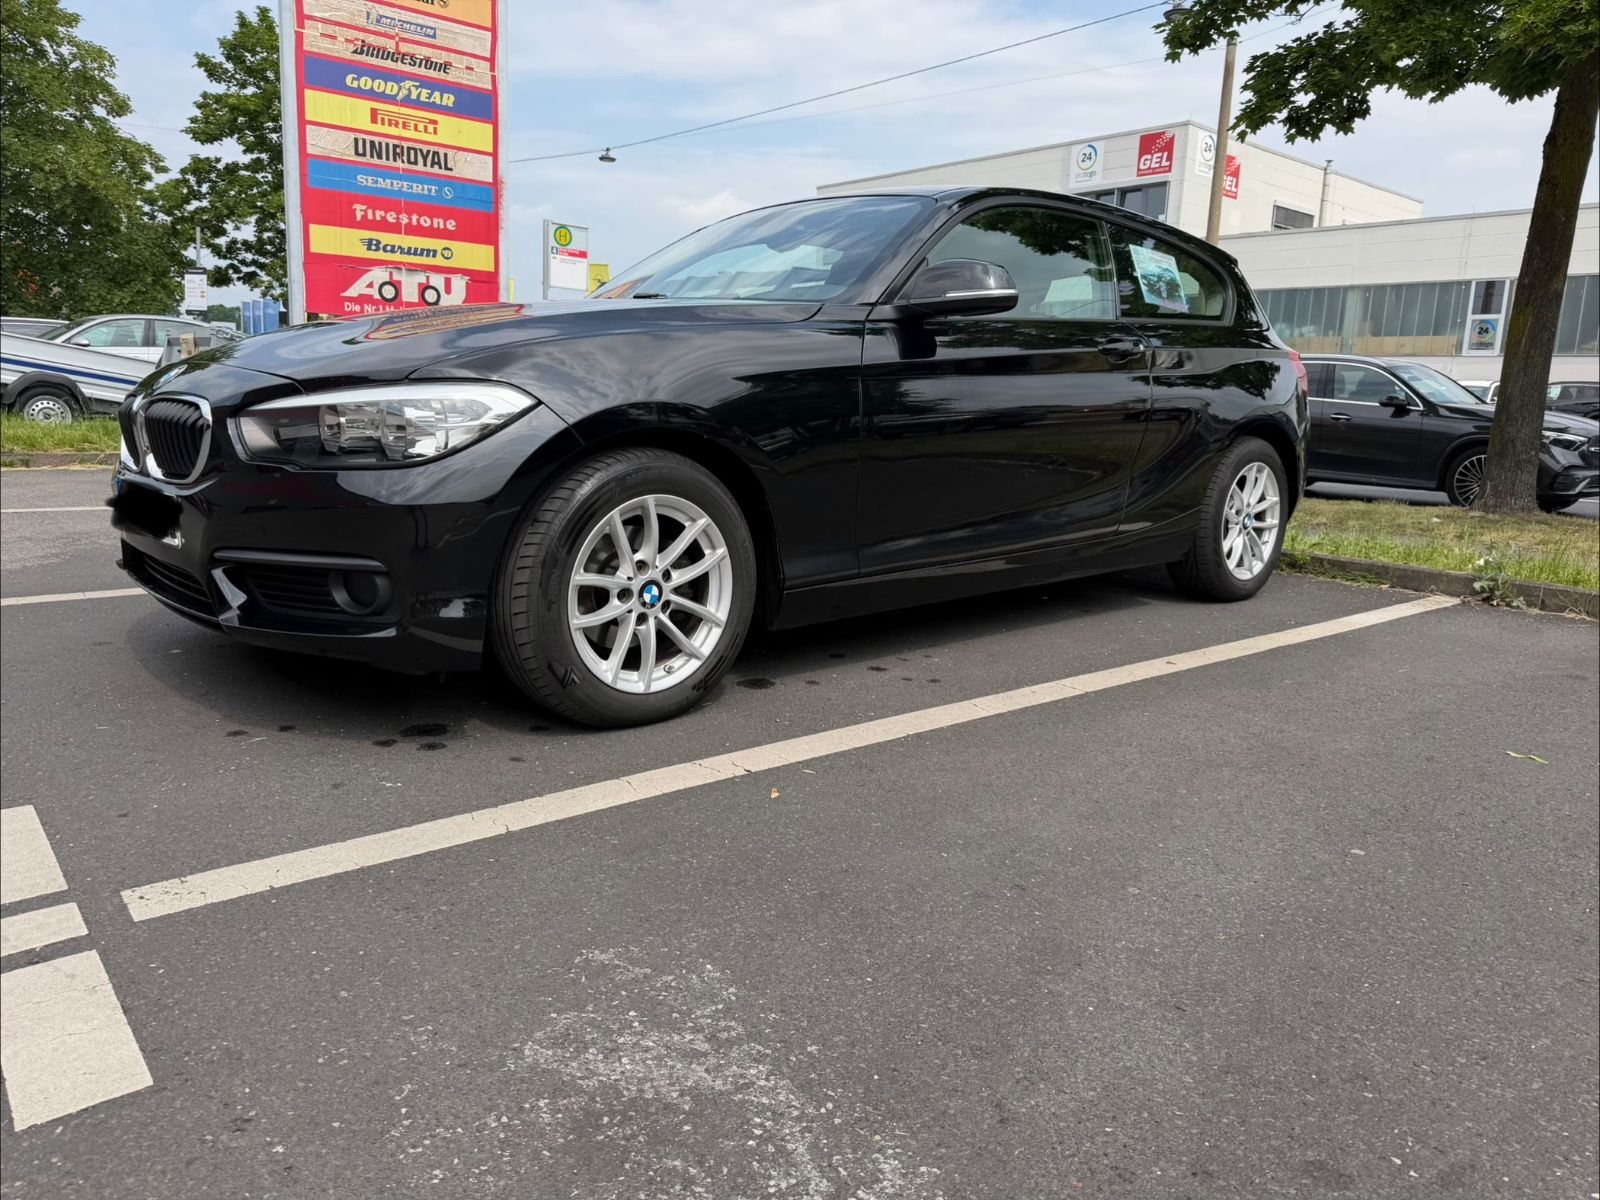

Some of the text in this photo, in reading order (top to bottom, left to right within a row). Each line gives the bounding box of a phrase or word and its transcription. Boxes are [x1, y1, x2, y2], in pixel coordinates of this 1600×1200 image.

[380, 17, 435, 36] MICHELIN
[350, 41, 451, 75] BRIDGESTONE
[345, 73, 455, 107] GOODYEAR
[369, 107, 439, 136] PIRELLI
[353, 136, 454, 171] UNIROYAL
[1081, 152, 1092, 163] 24
[1202, 141, 1212, 153] 24
[1139, 152, 1170, 170] GEL
[356, 174, 438, 197] SEMPERIT
[352, 203, 457, 231] Firestone
[559, 229, 568, 243] H
[360, 238, 439, 259] Barum
[340, 265, 471, 306] ATU
[344, 301, 361, 313] Die
[1477, 326, 1490, 336] 24
